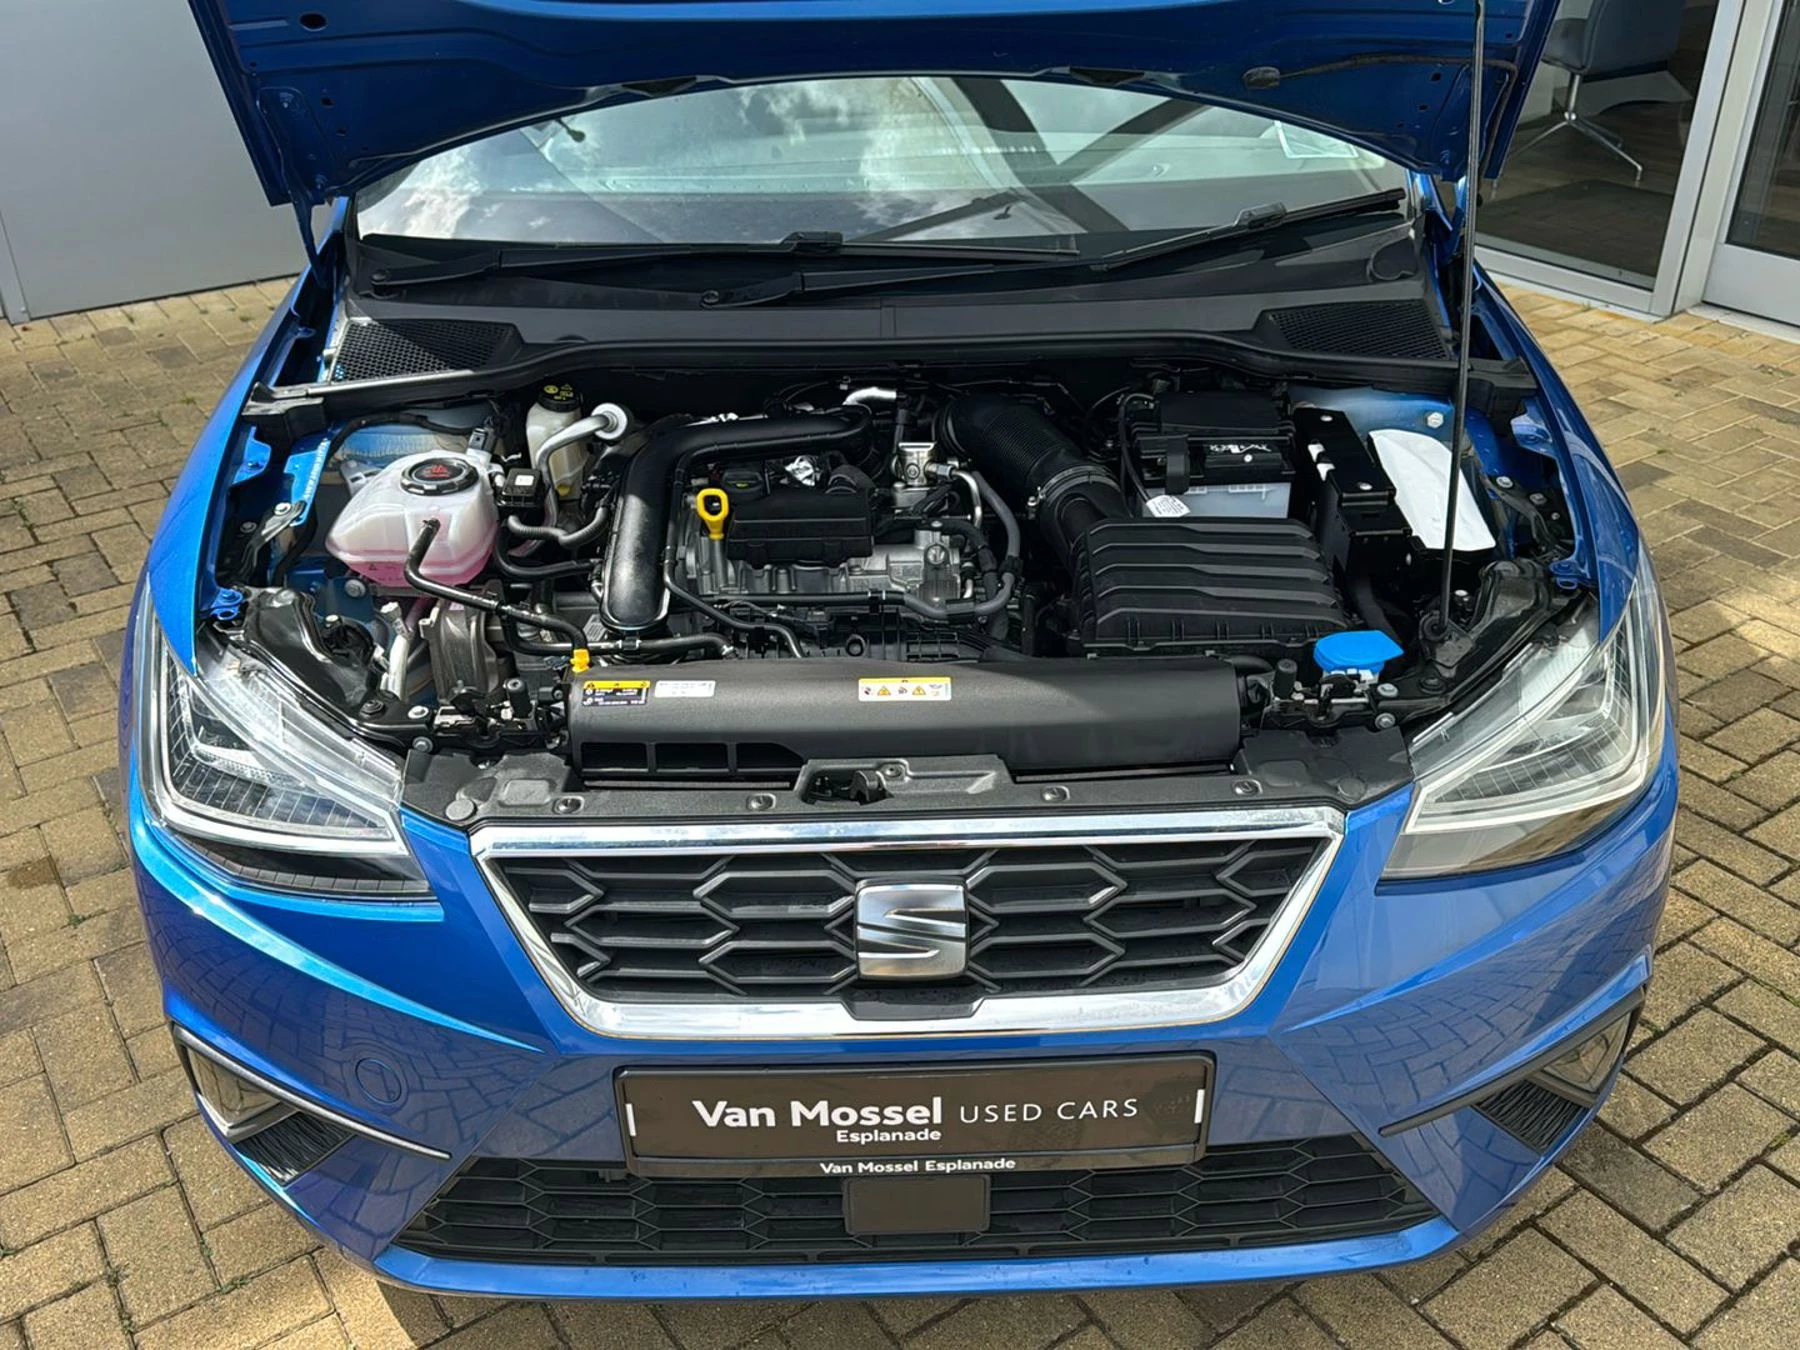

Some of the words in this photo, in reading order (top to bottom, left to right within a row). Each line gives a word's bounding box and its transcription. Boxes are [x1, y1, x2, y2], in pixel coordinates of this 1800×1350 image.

[692, 1100, 776, 1128] Van
[790, 1096, 942, 1127] Mossel
[960, 1103, 1042, 1124] USED
[1057, 1098, 1138, 1120] CARS
[836, 1127, 942, 1145] Esplanade
[820, 1163, 853, 1174] Van
[857, 1160, 919, 1174] Mossel
[925, 1157, 1016, 1174] Esplanade
